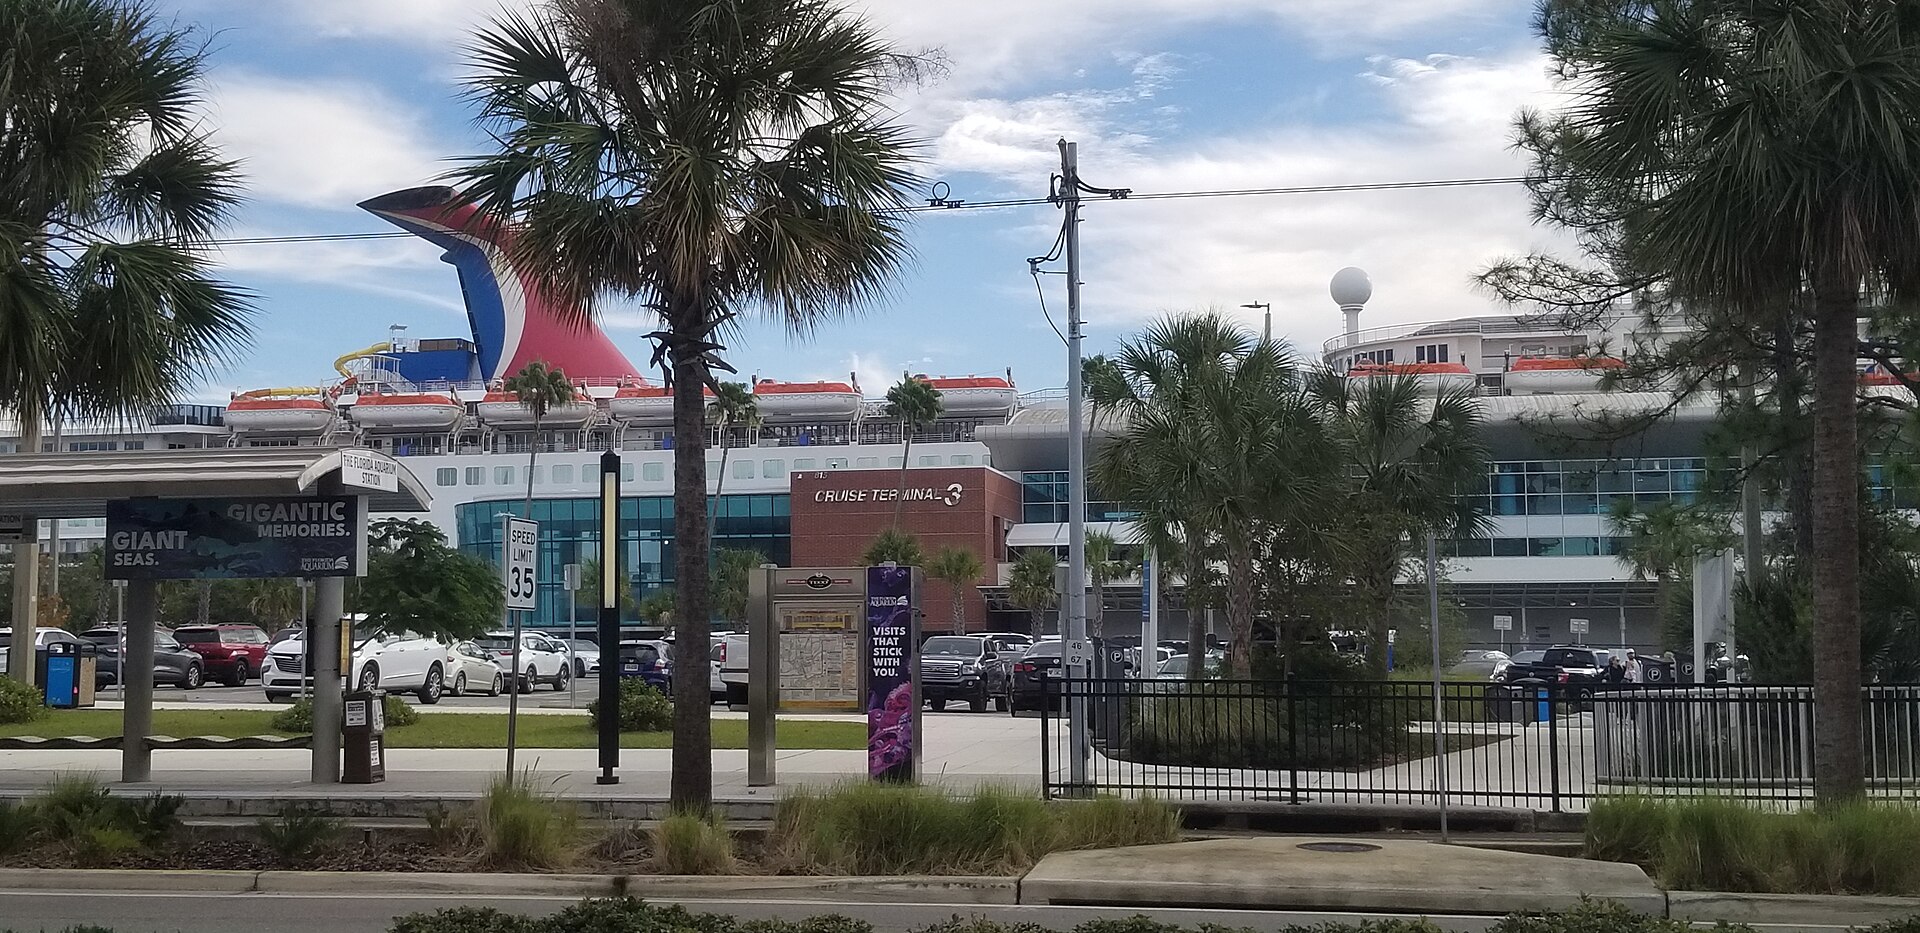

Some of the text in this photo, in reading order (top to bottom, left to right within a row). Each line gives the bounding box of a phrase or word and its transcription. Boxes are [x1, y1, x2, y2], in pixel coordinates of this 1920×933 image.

[344, 454, 397, 476] THE FLORIDA AQUARIUM
[362, 472, 381, 486] STATION
[815, 483, 963, 506] CRUISE TERMINAL 3
[227, 502, 346, 522] GIGANTIC
[258, 523, 351, 538] MEMORIES.
[512, 530, 536, 545] SPEED
[112, 530, 188, 550] GIANT
[113, 552, 159, 566] SEAS.
[513, 548, 533, 563] LIMIT
[300, 561, 335, 571] AQUARIUM
[510, 566, 534, 599] 35
[873, 627, 906, 636] VISITS
[873, 637, 899, 646] THAT
[1071, 642, 1082, 650] 46
[873, 647, 903, 656] STICK
[1114, 652, 1121, 661] P
[873, 658, 900, 667] WITH
[1070, 655, 1082, 664] 67
[873, 668, 899, 677] YOU.
